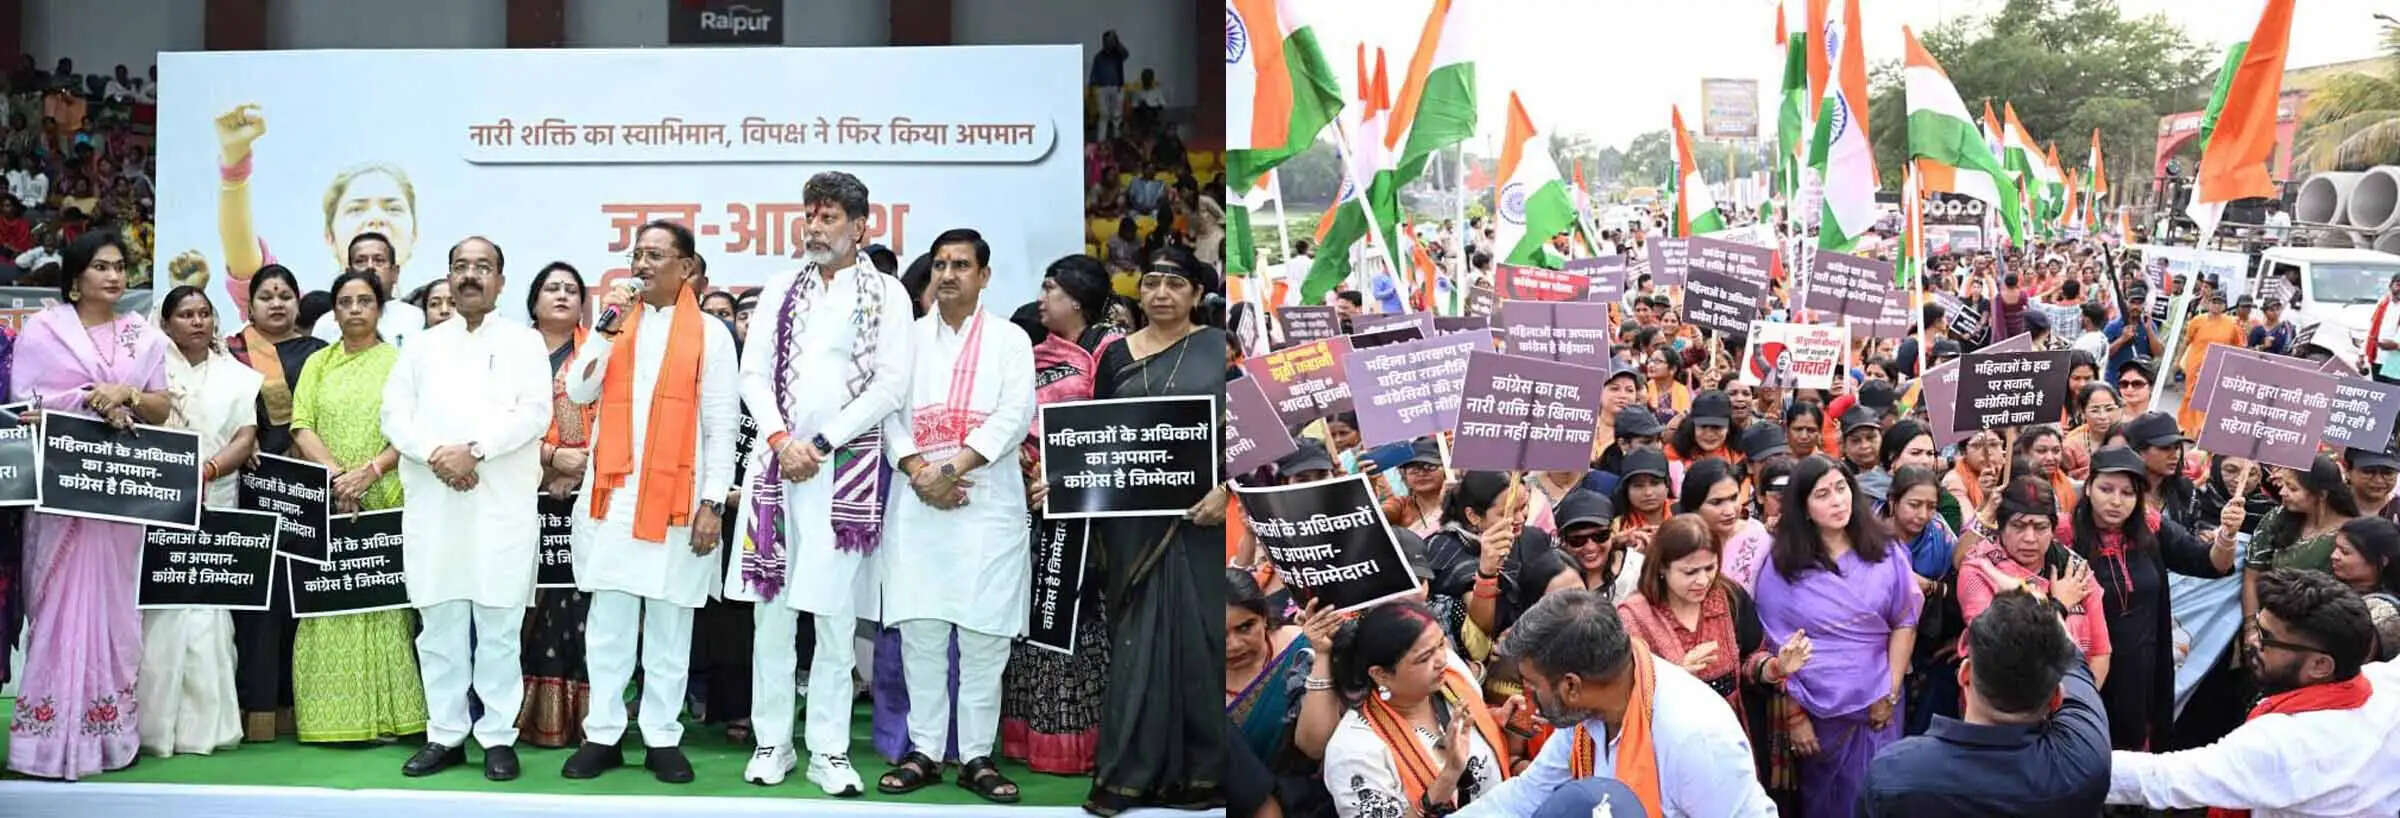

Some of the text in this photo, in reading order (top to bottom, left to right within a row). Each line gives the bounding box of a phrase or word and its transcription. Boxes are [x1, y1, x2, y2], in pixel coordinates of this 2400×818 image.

[701, 11, 771, 36] Raipur
[470, 116, 1034, 150] नारी शक्ति का स्वाभिमान, विपक्ष ने फिर किया अपमान
[1975, 358, 2052, 375] महिलाओं के हक
[1492, 374, 1581, 401] कांग्रेस का हाथ,
[1988, 381, 2002, 391] पर
[2221, 375, 2329, 409] कांग्रेस द्वारा नारी शक्ति
[1974, 389, 2045, 409] कांग्रेसियों की है
[2370, 391, 2386, 402] पर
[1466, 395, 1594, 424] नारी शक्ति के खिलाफ,
[2231, 399, 2311, 426] का अपमान नहीं
[1981, 412, 2010, 429] पुरानी
[2220, 417, 2251, 436] सहेगा
[2346, 415, 2367, 428] रही
[2366, 417, 2376, 432] है
[1049, 422, 1208, 446] महिलाओं के अधिकारों
[1462, 421, 1592, 443] जनता नहीं करेगी माफ
[48, 435, 195, 466] महिलाओं के अधिकारों
[1086, 450, 1173, 465] का अपमान-
[81, 459, 162, 479] का अपमान-
[59, 473, 181, 501] कांग्रेस है जिम्मेदार।
[1064, 470, 1195, 490] कांग्रेस है जिम्मेदार।
[278, 479, 286, 494] के
[288, 483, 324, 502] अधिकारों
[259, 497, 303, 516] का अपमान-
[1280, 518, 1296, 537] के
[1297, 505, 1375, 537] अधिकारों
[199, 530, 212, 545] के
[214, 532, 271, 548] अधिकारों
[345, 538, 358, 551] के
[170, 552, 238, 565] का अपमान-
[340, 555, 390, 570] अपमान-
[1269, 544, 1341, 562] का अपमान-
[152, 567, 254, 585] कांग्रेस है जिम्मेदार।
[304, 571, 407, 592] कांग्रेस है जिम्मेदार
[1302, 559, 1380, 588] जिम्मेदार।
